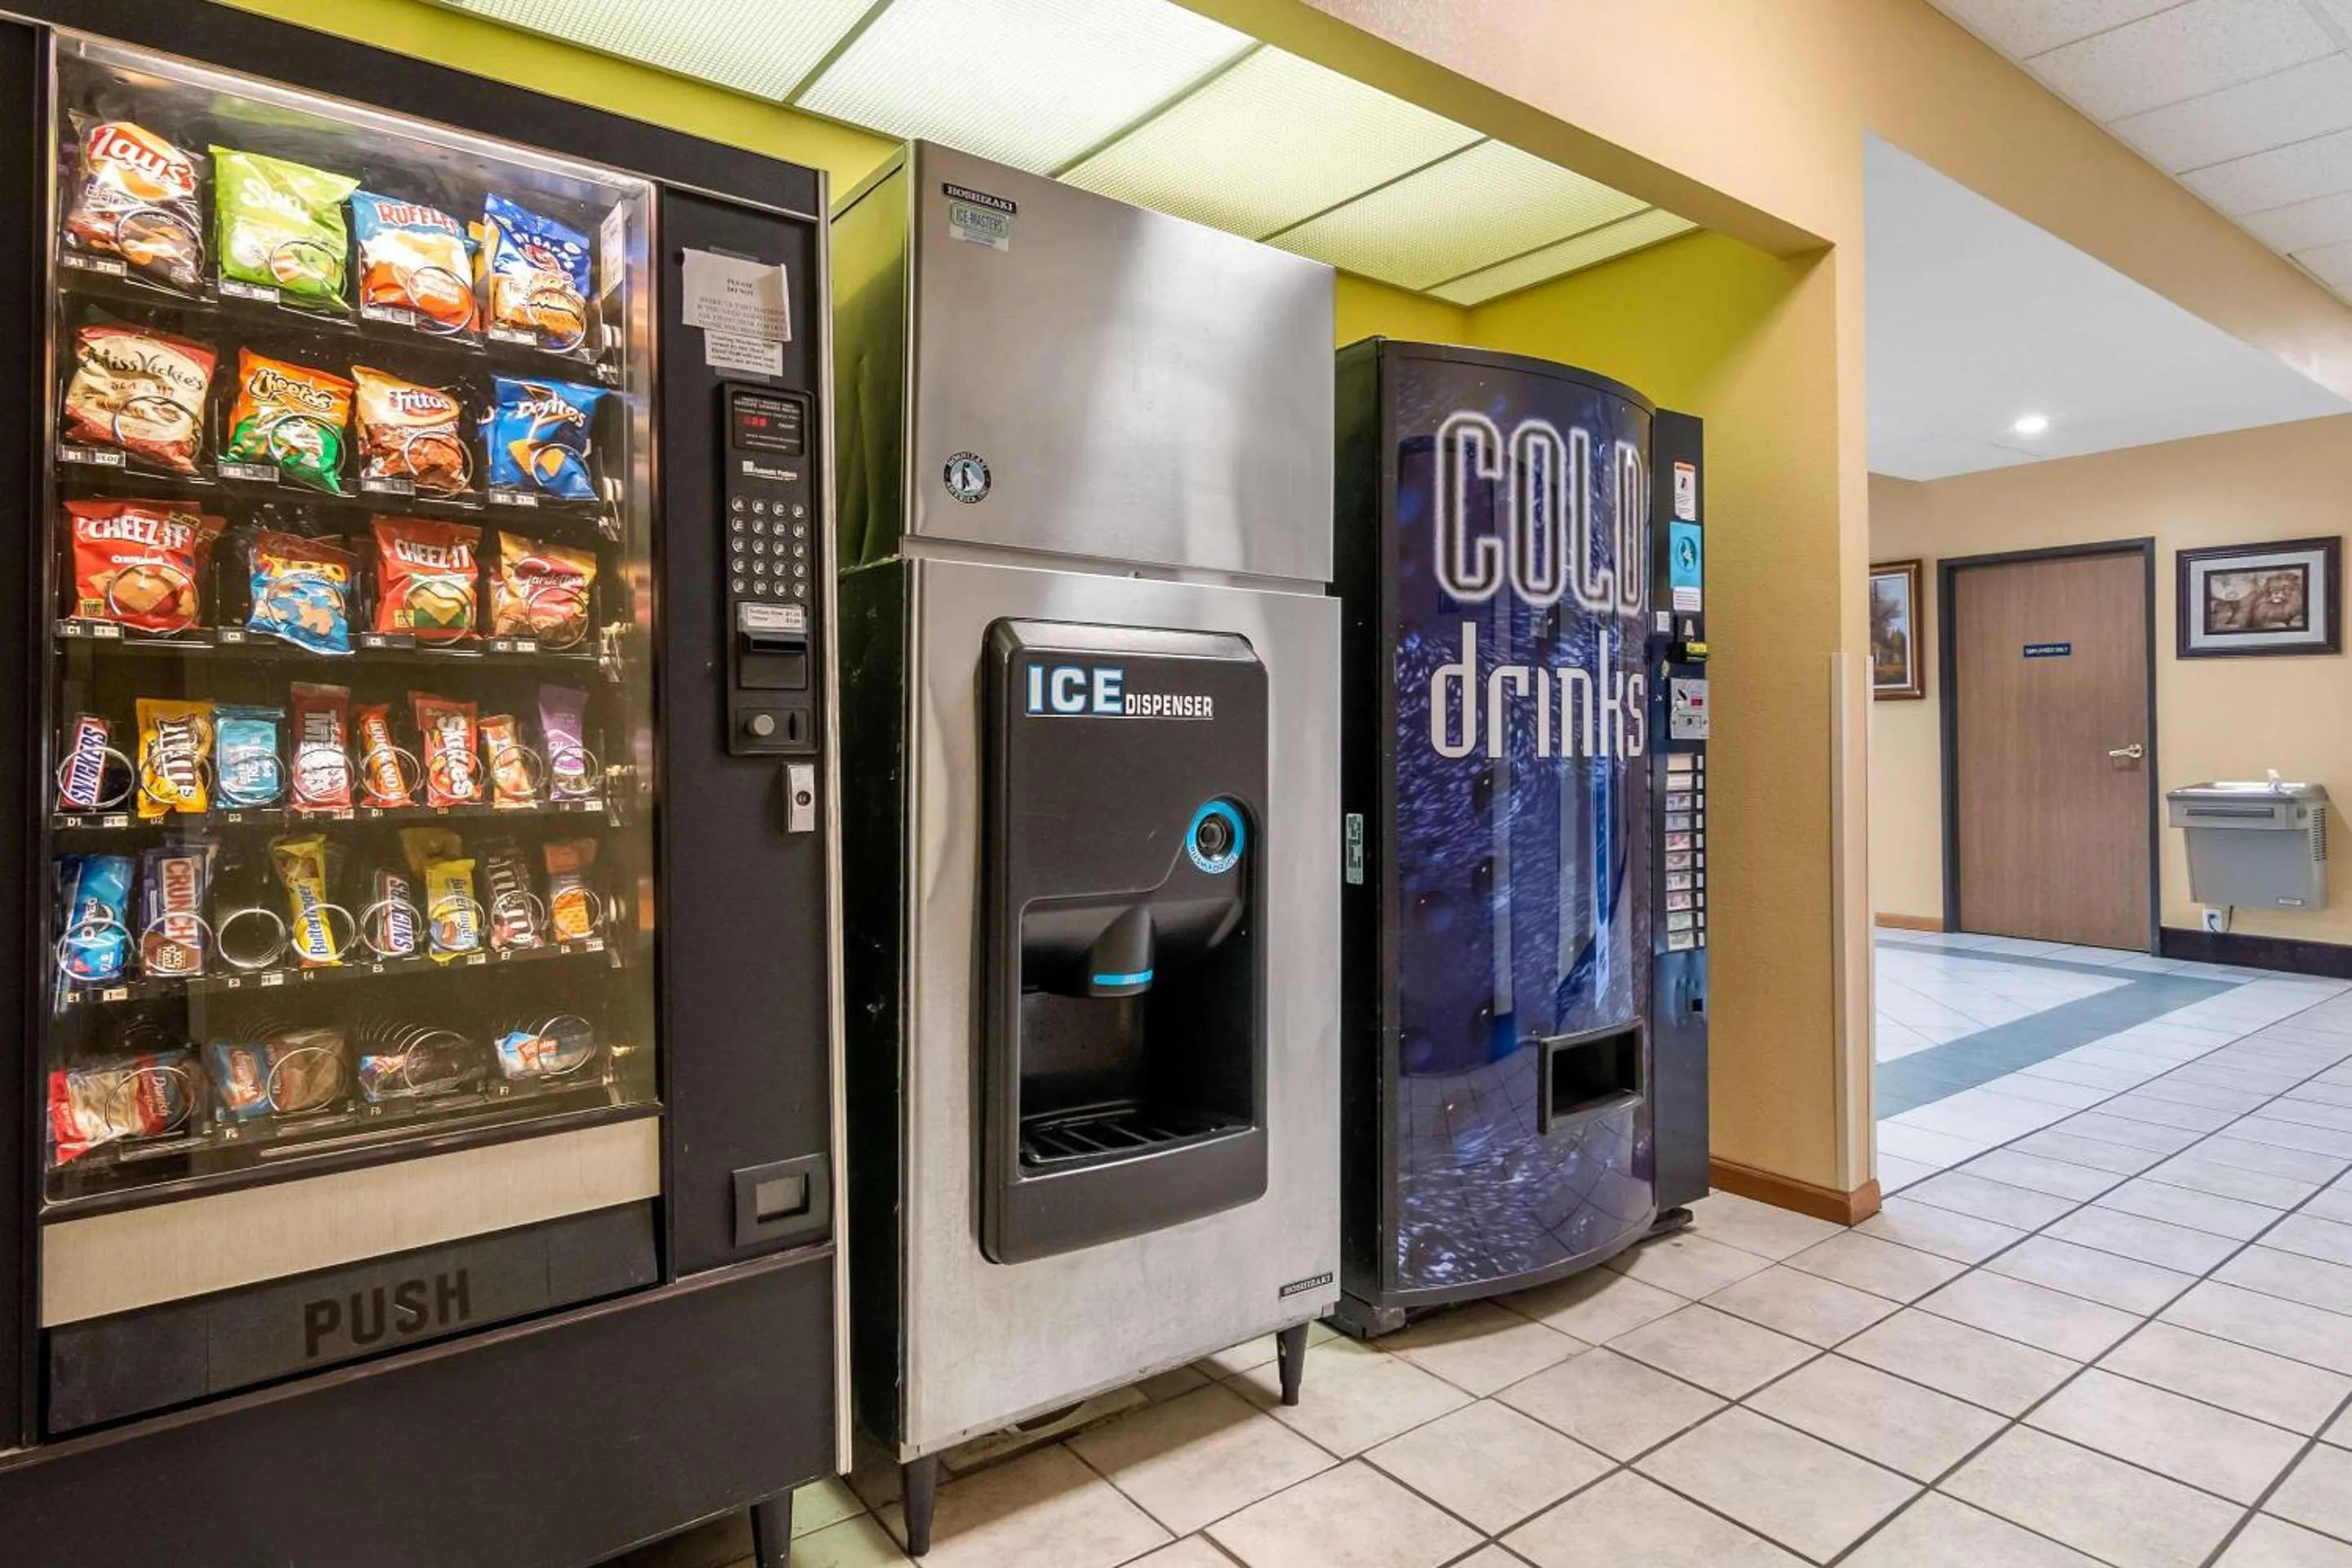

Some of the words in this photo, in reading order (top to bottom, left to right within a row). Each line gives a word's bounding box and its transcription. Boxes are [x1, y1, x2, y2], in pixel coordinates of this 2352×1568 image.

[947, 185, 1013, 211] HOSHIZAKI
[248, 368, 333, 411] Cheetos
[389, 390, 452, 412] Fritos
[1435, 412, 1643, 615] COLD
[1027, 664, 1124, 714] ICE
[1125, 694, 1214, 716] DISPENSER
[1431, 621, 1644, 761] drinks
[70, 726, 108, 805] SNICKERS
[166, 860, 195, 939] CRUNCH
[304, 1268, 470, 1358] PUSH
